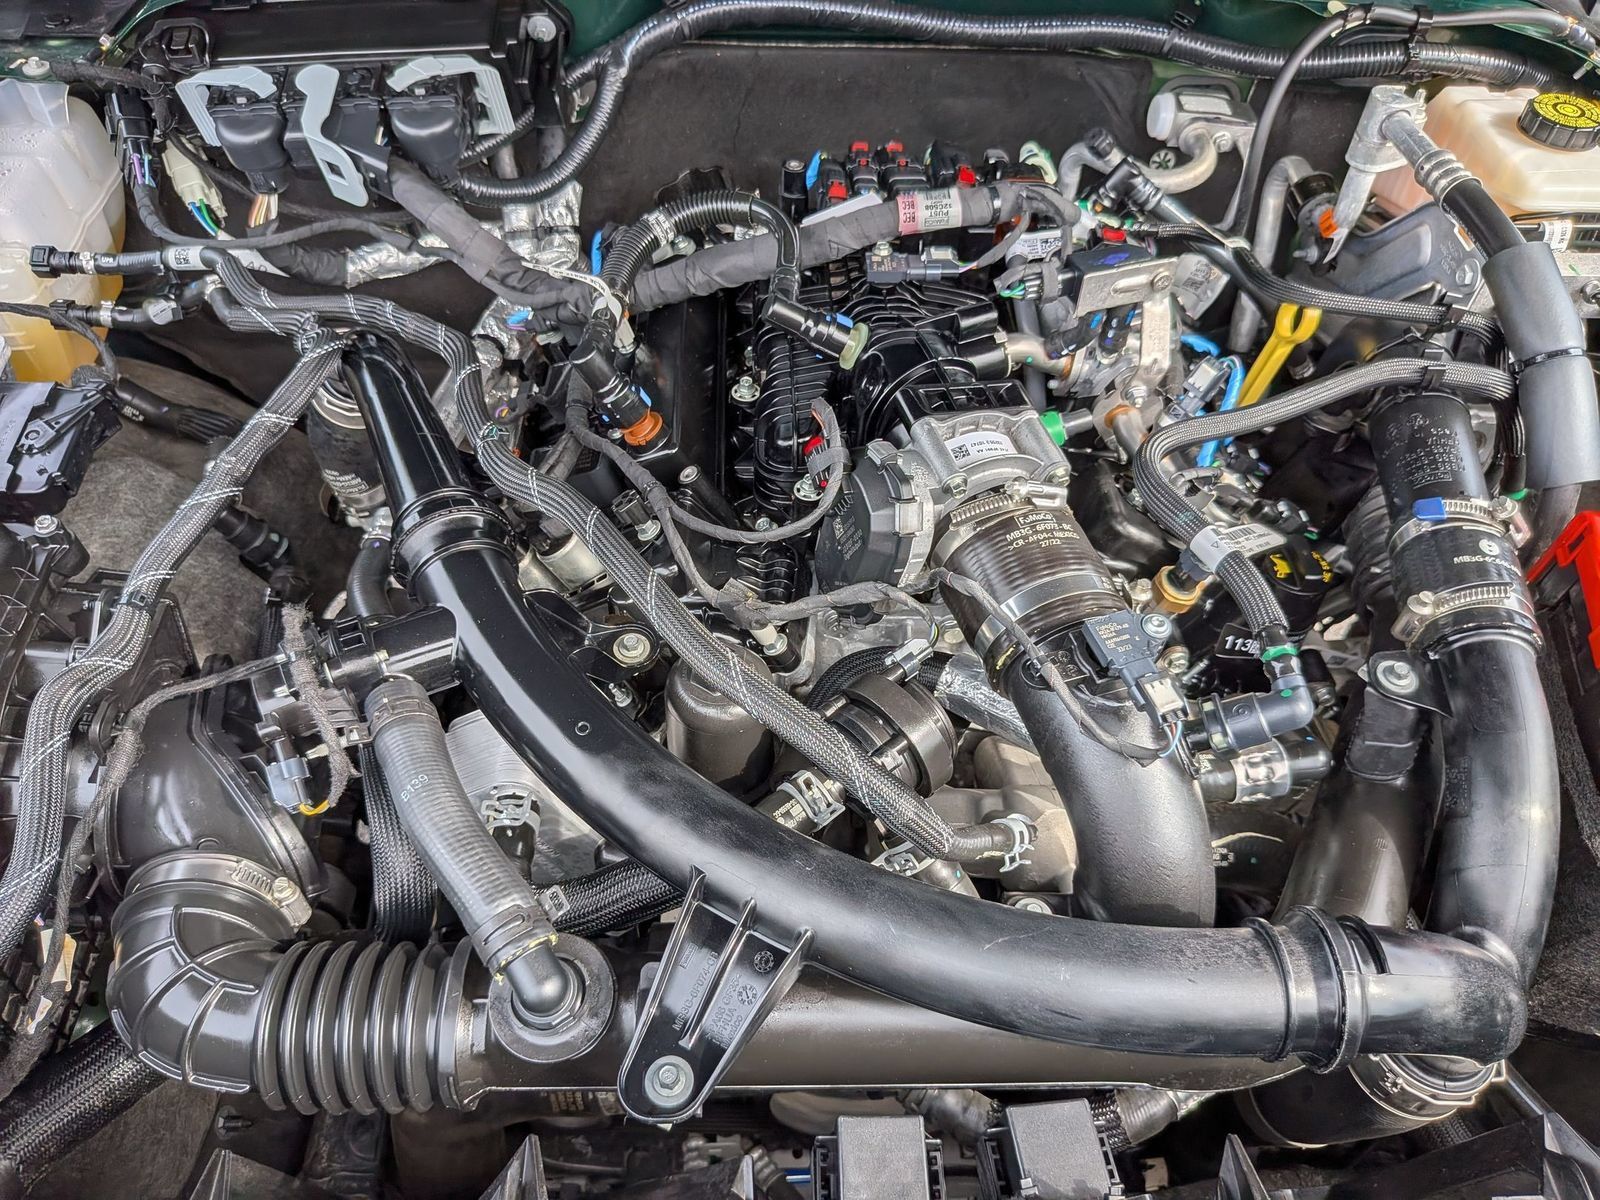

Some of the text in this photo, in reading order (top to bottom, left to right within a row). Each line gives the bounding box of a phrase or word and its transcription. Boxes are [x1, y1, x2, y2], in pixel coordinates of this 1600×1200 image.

[902, 200, 915, 210] BEC
[902, 213, 916, 223] BEC
[1019, 512, 1052, 524] FoMoCo
